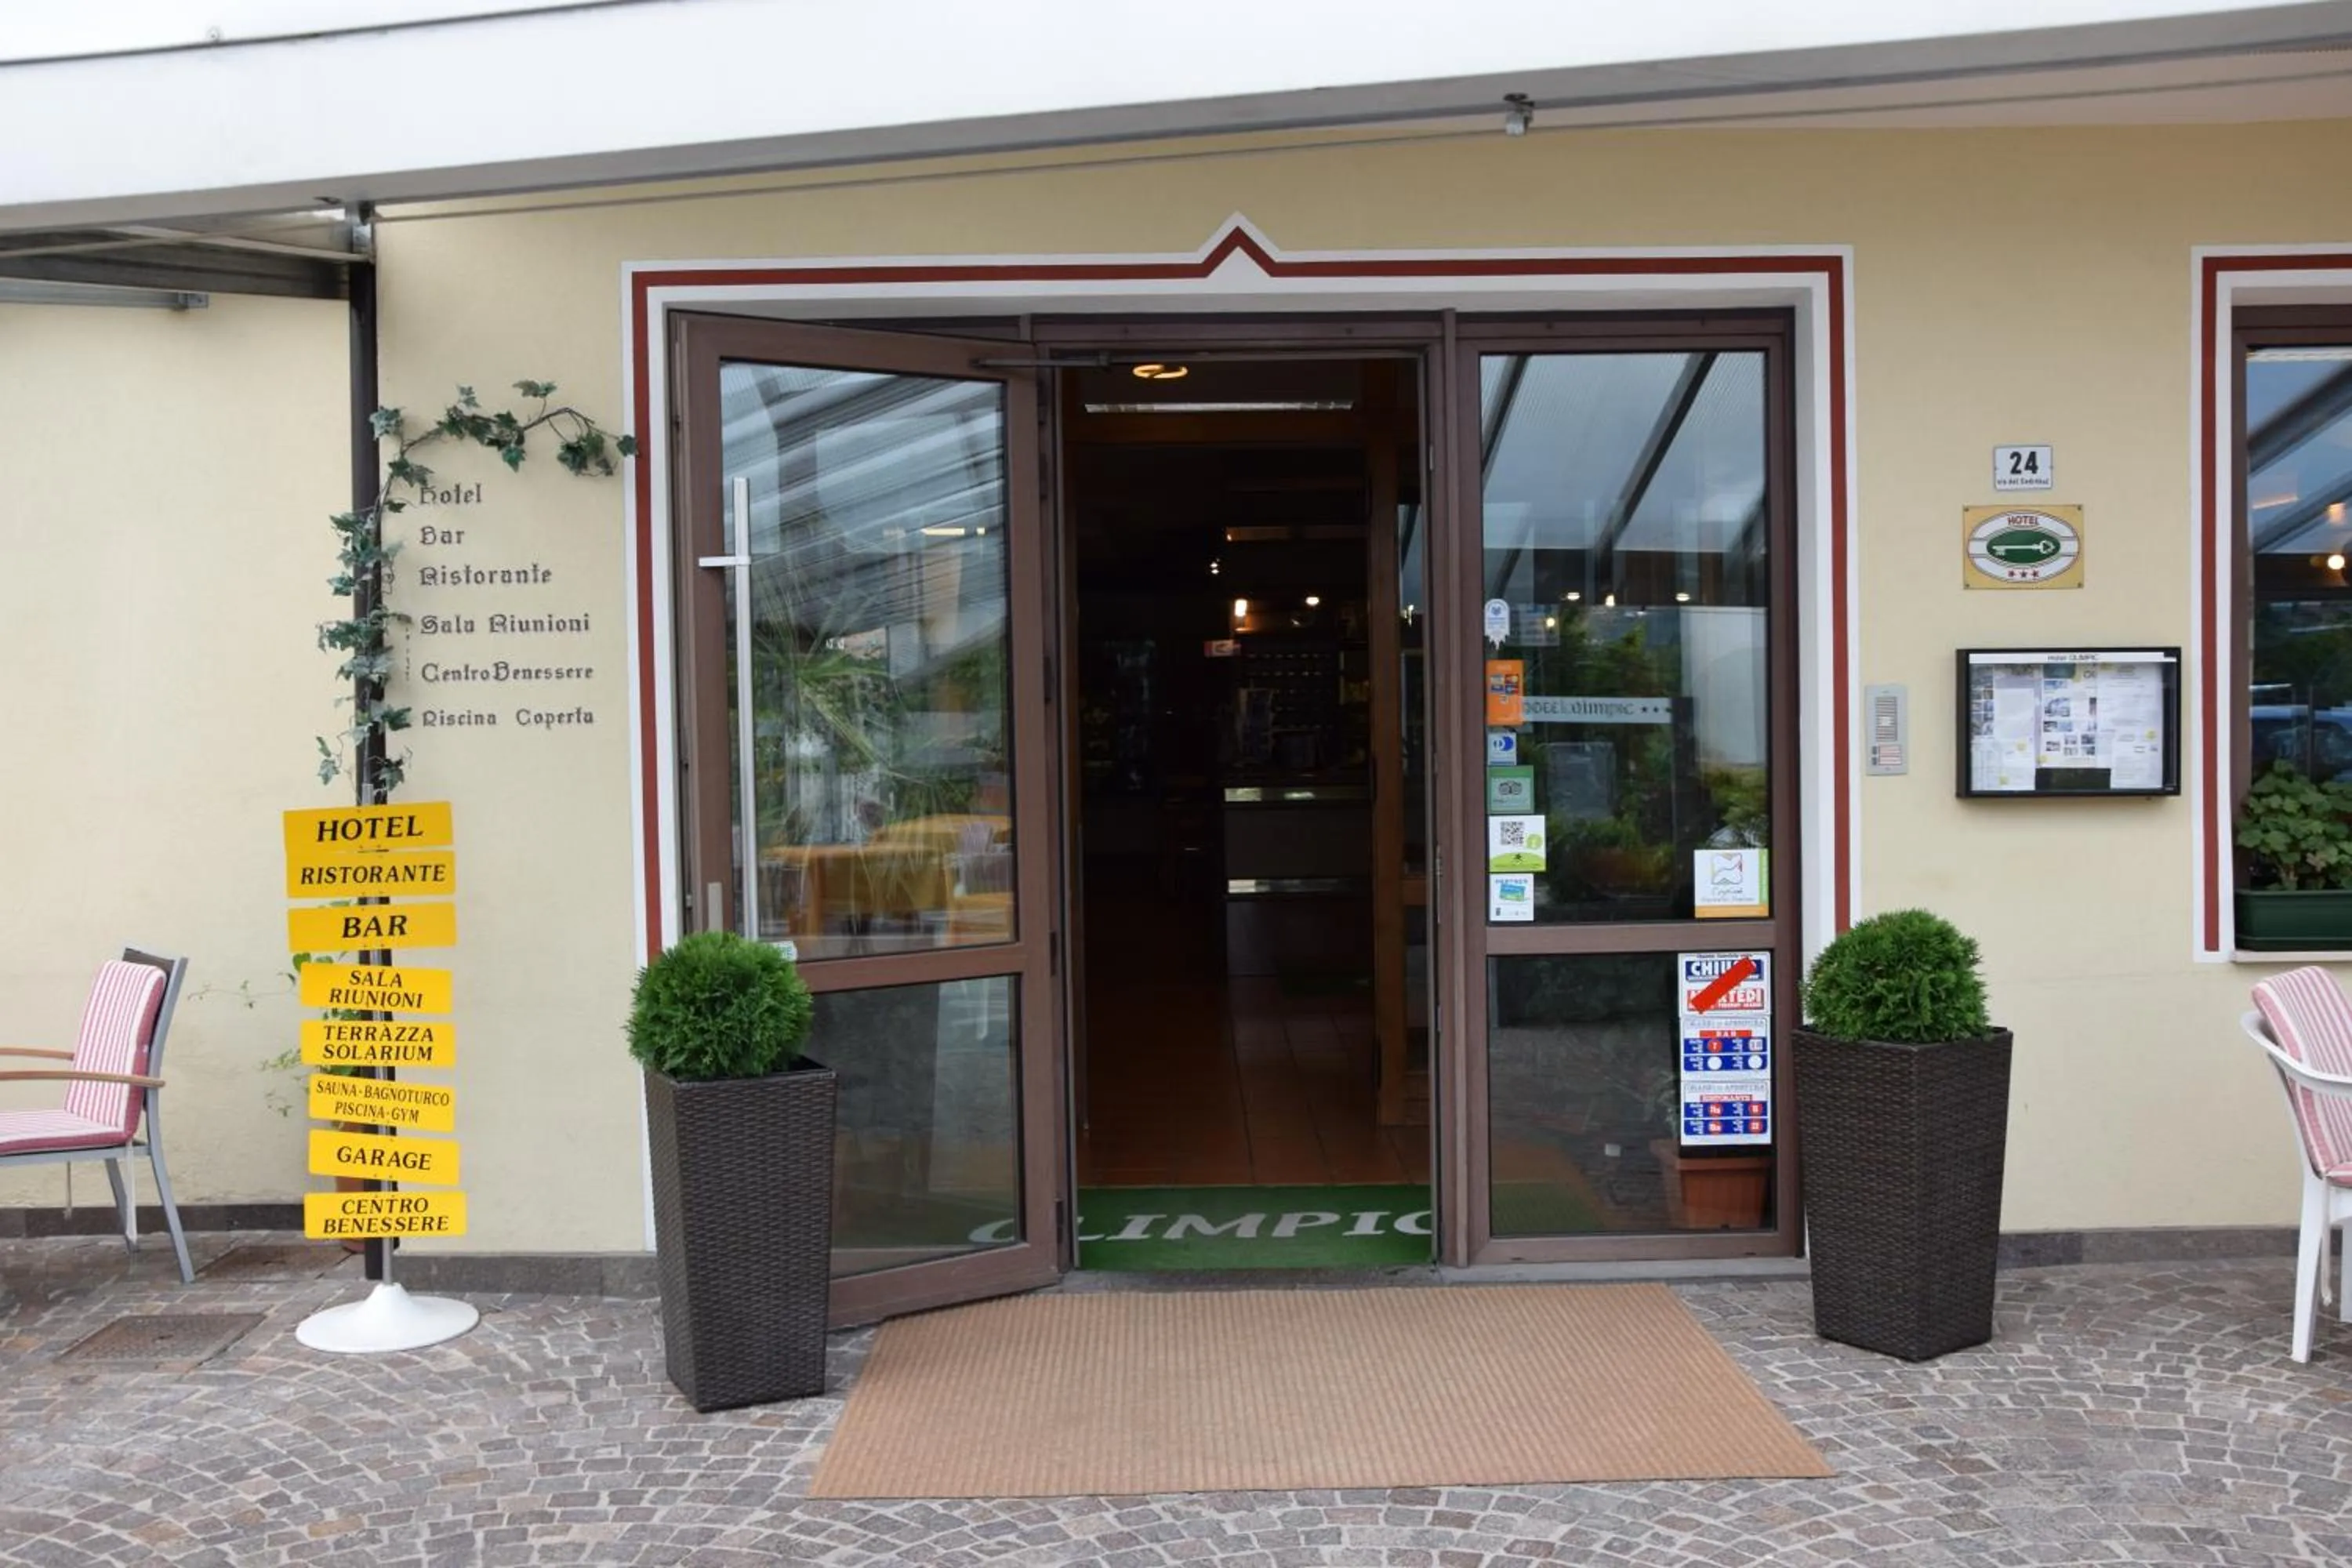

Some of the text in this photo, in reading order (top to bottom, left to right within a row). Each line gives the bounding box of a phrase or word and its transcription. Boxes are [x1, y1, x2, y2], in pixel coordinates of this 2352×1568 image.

[2009, 451, 2038, 474] 24
[420, 482, 482, 506] Hotel
[2008, 515, 2039, 525] HOTEL
[420, 525, 465, 546] Bar
[419, 562, 553, 586] Ristorante
[420, 612, 590, 634] Sala Riunioni
[516, 707, 594, 731] Coperta
[316, 815, 423, 842] HOTEL
[300, 864, 446, 885] RISTORANTE
[342, 914, 408, 938] BAR
[1691, 960, 1757, 976] CHIU
[349, 970, 403, 988] SALA
[328, 988, 423, 1008] RIUNIONI
[323, 1025, 434, 1043] TERRAZZA
[322, 1044, 433, 1062] SOLARIUM
[336, 1145, 432, 1171] GARAGE
[341, 1197, 429, 1215] CENTRO
[323, 1215, 449, 1234] BENESSERE
